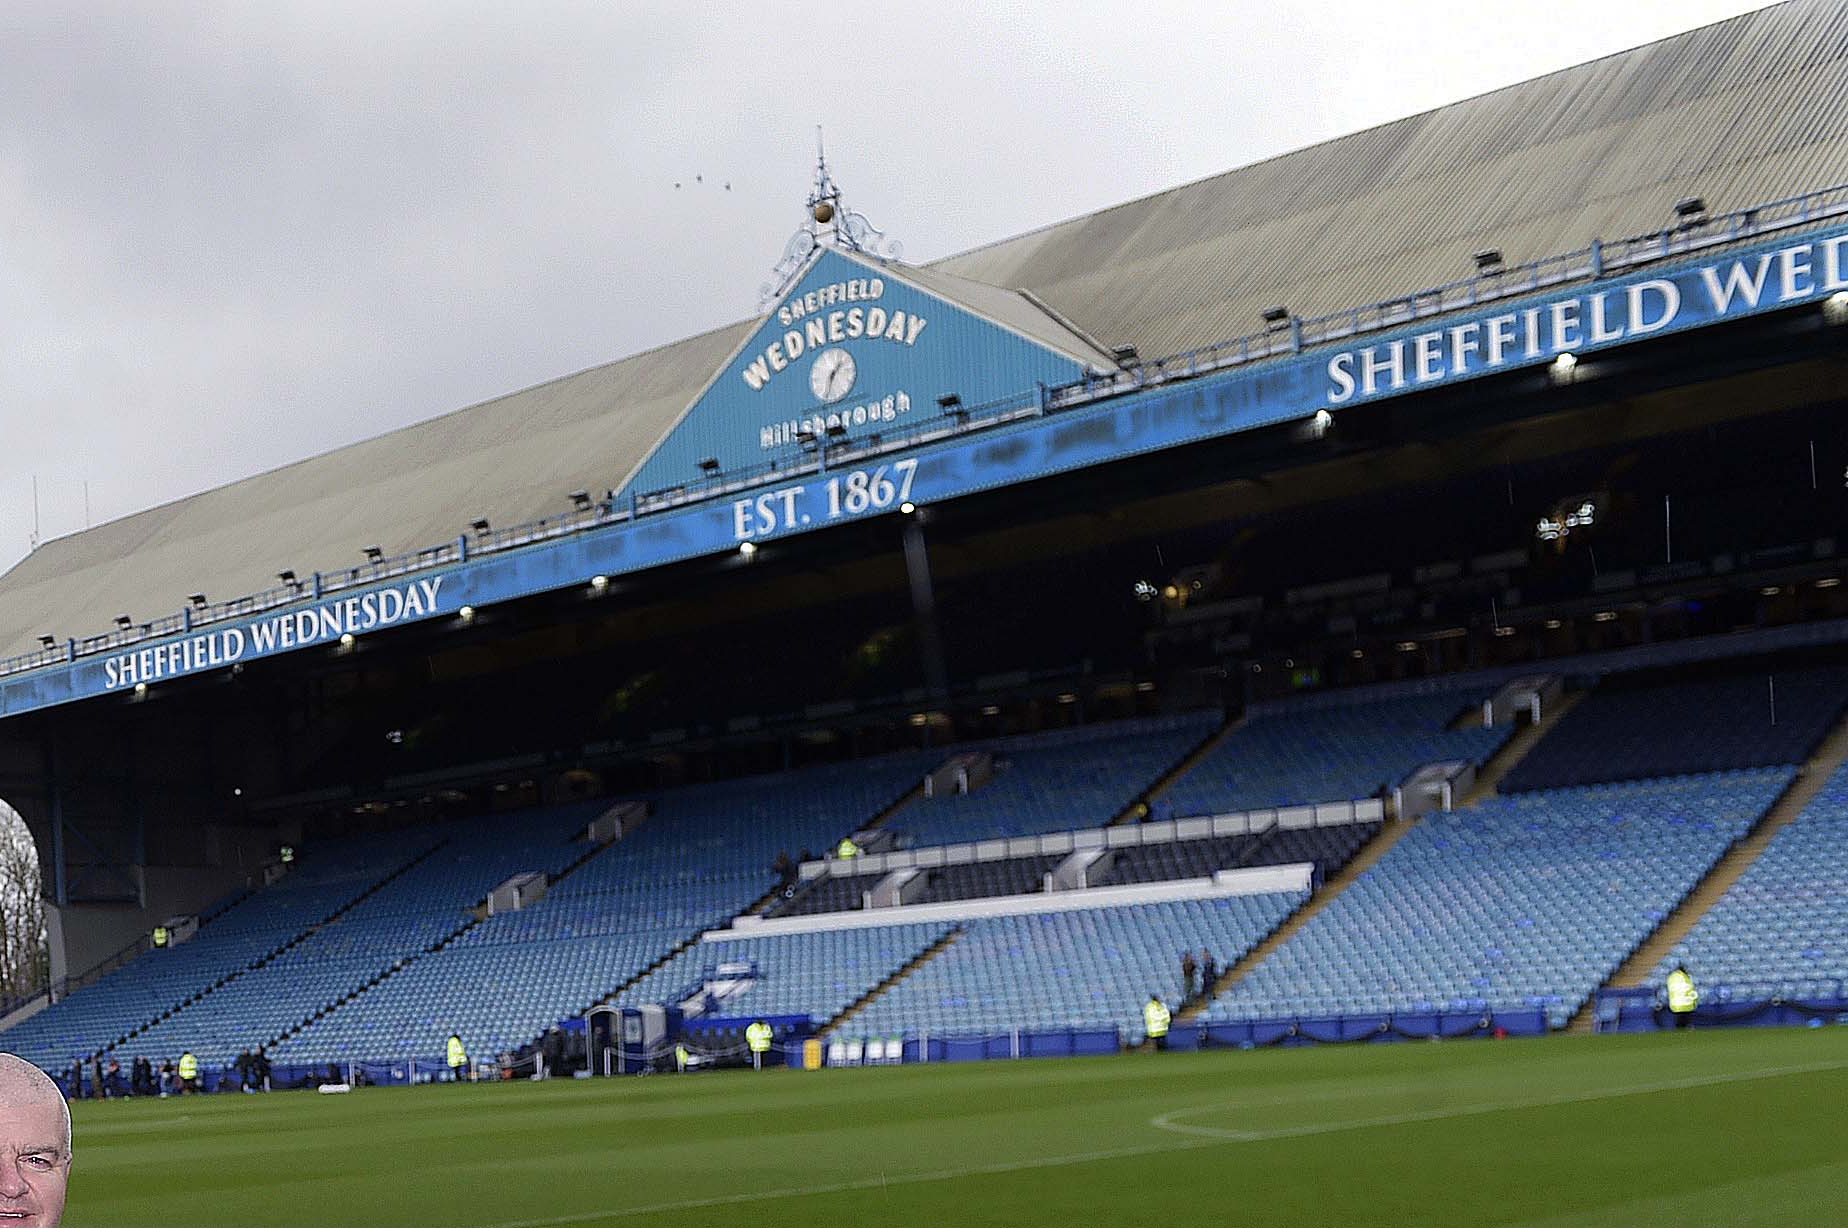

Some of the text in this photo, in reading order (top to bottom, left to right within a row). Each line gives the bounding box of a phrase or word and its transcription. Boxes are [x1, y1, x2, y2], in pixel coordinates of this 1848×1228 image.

[778, 279, 884, 326] SHEFFIELD
[1326, 278, 1681, 403] SHEFFIELD
[743, 307, 927, 391] WEDNESDAY
[733, 458, 919, 539] EST. 1867
[104, 576, 442, 689] SHEFFIELD WEDNESDAY
